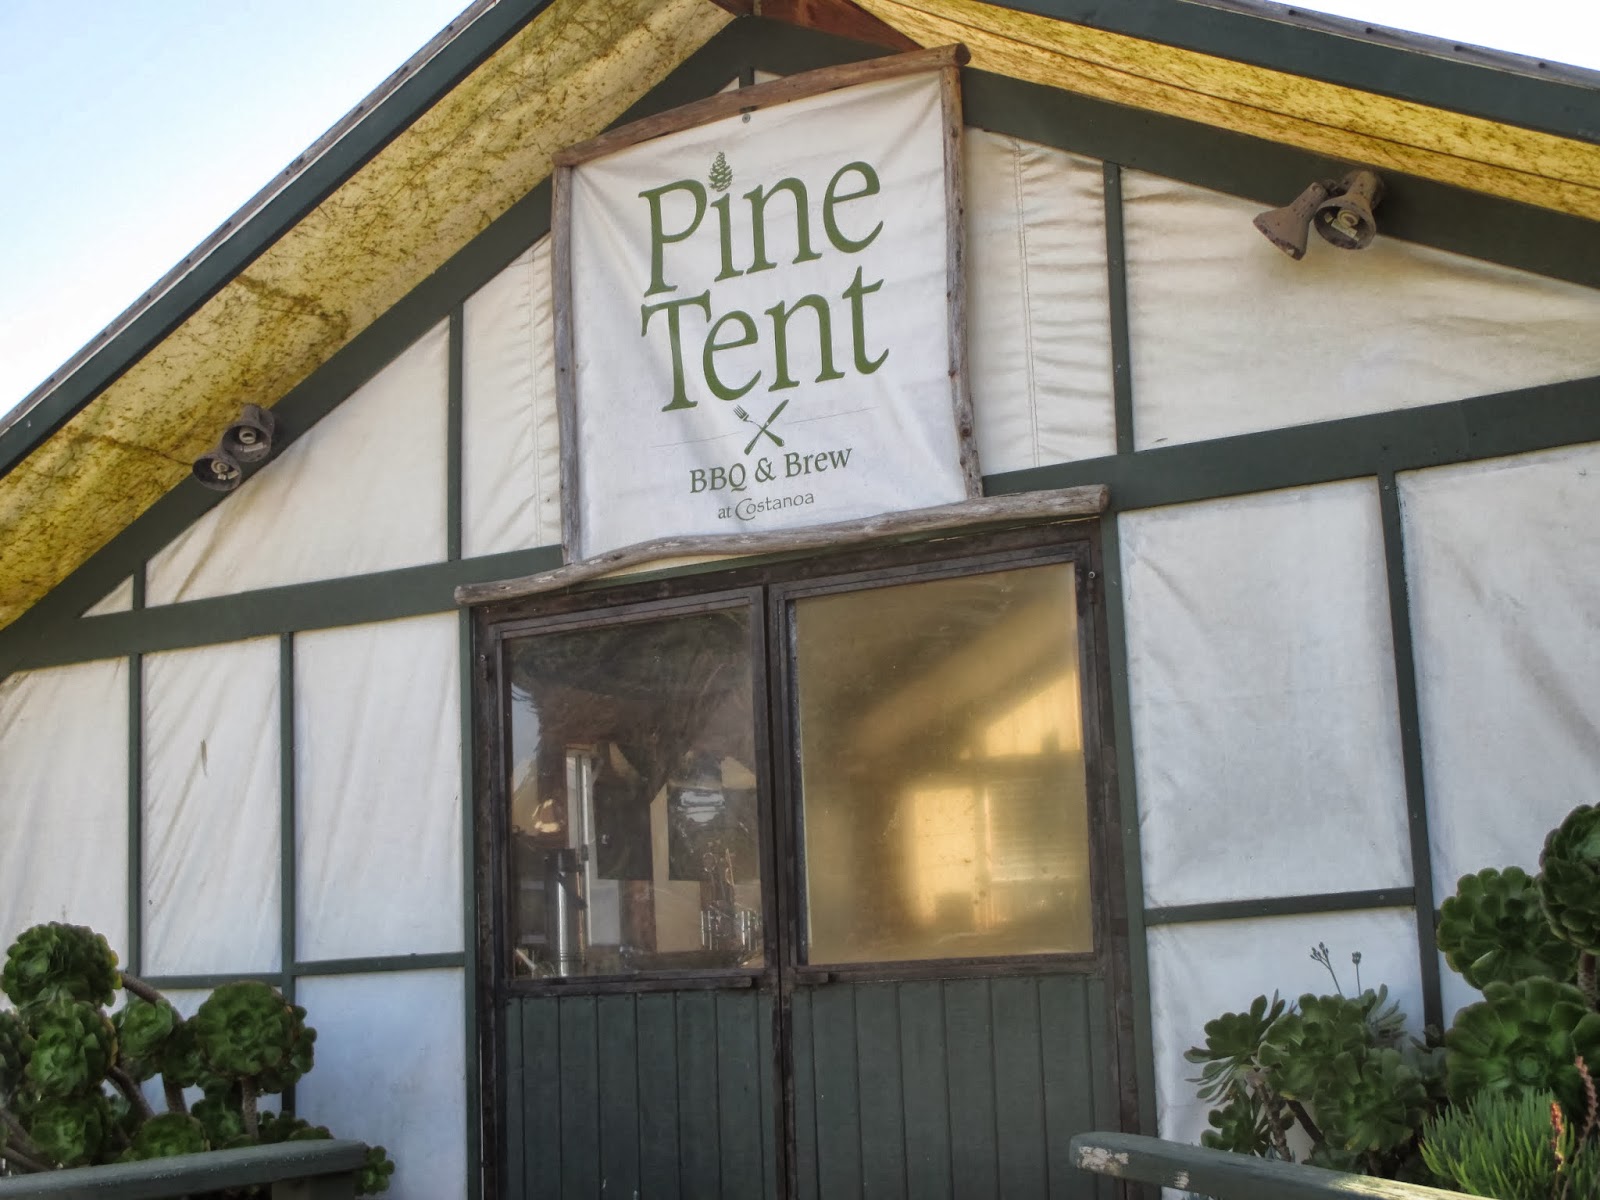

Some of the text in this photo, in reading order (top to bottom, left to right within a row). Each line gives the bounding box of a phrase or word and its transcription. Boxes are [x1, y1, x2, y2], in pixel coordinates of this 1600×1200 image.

[638, 155, 884, 298] Pine
[640, 266, 889, 412] Tent
[689, 448, 852, 493] BBQ & Brew
[718, 493, 815, 521] at Costanoa
